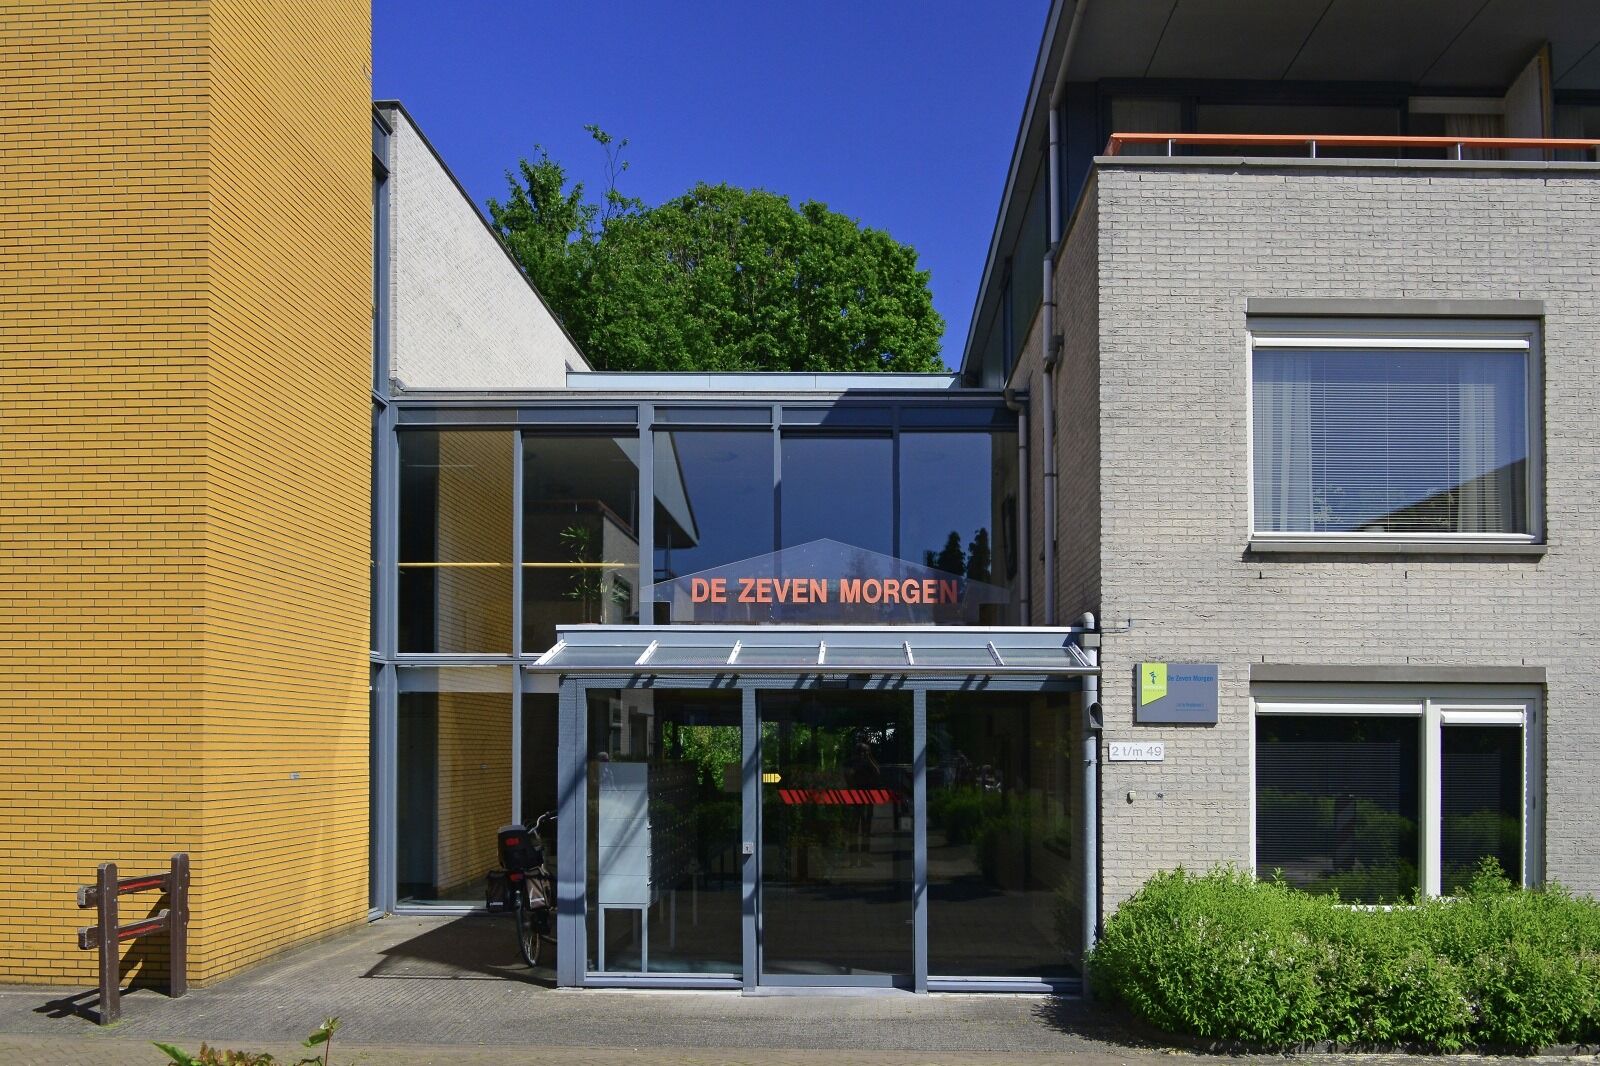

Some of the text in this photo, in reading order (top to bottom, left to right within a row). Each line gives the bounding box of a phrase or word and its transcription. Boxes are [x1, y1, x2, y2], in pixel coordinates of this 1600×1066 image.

[691, 578, 958, 604] DE ZEVEN MORGEN
[1167, 674, 1214, 683] De Zeven Morgen
[1112, 746, 1162, 756] 2 t/m 49
